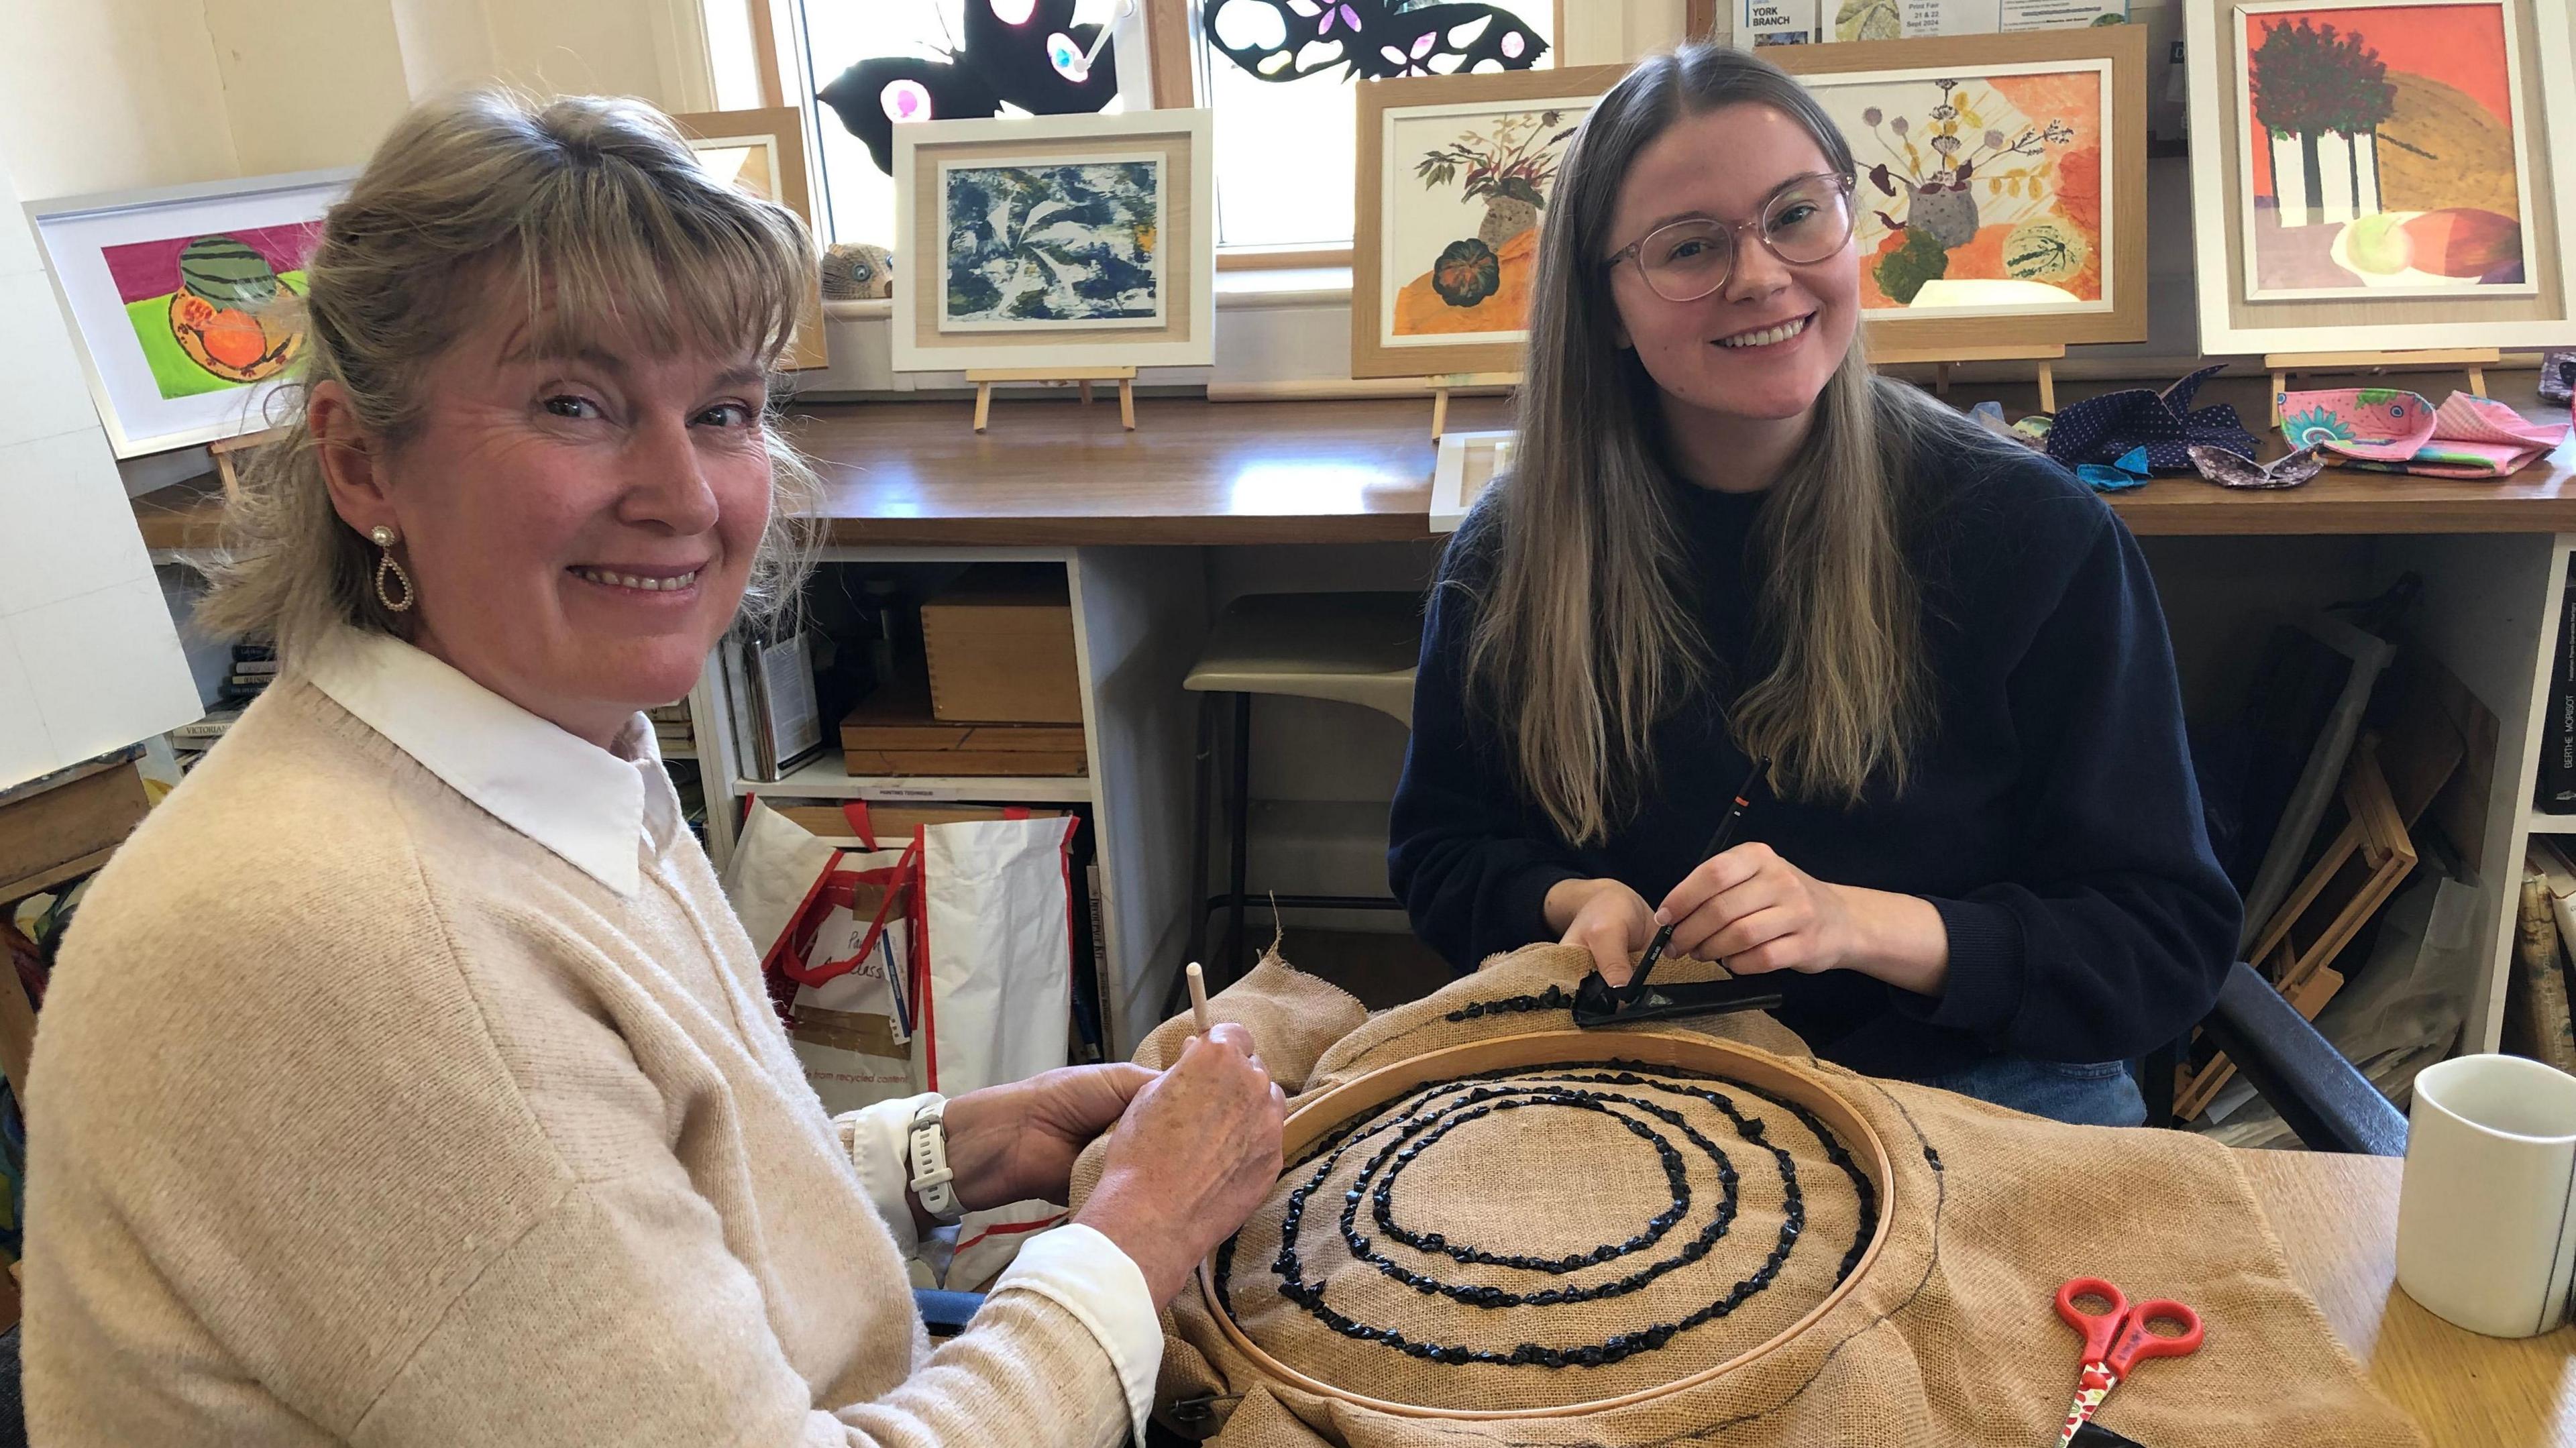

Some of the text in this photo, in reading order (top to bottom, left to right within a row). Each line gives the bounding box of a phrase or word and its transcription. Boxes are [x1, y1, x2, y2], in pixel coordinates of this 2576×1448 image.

[1752, 7, 1778, 16] YORK
[1753, 16, 1790, 26] BRANCH
[2564, 695, 2575, 769] BERTHE MORISOT
[814, 1068, 833, 1080] from
[836, 1071, 875, 1084] recycled
[877, 1074, 909, 1084] content
